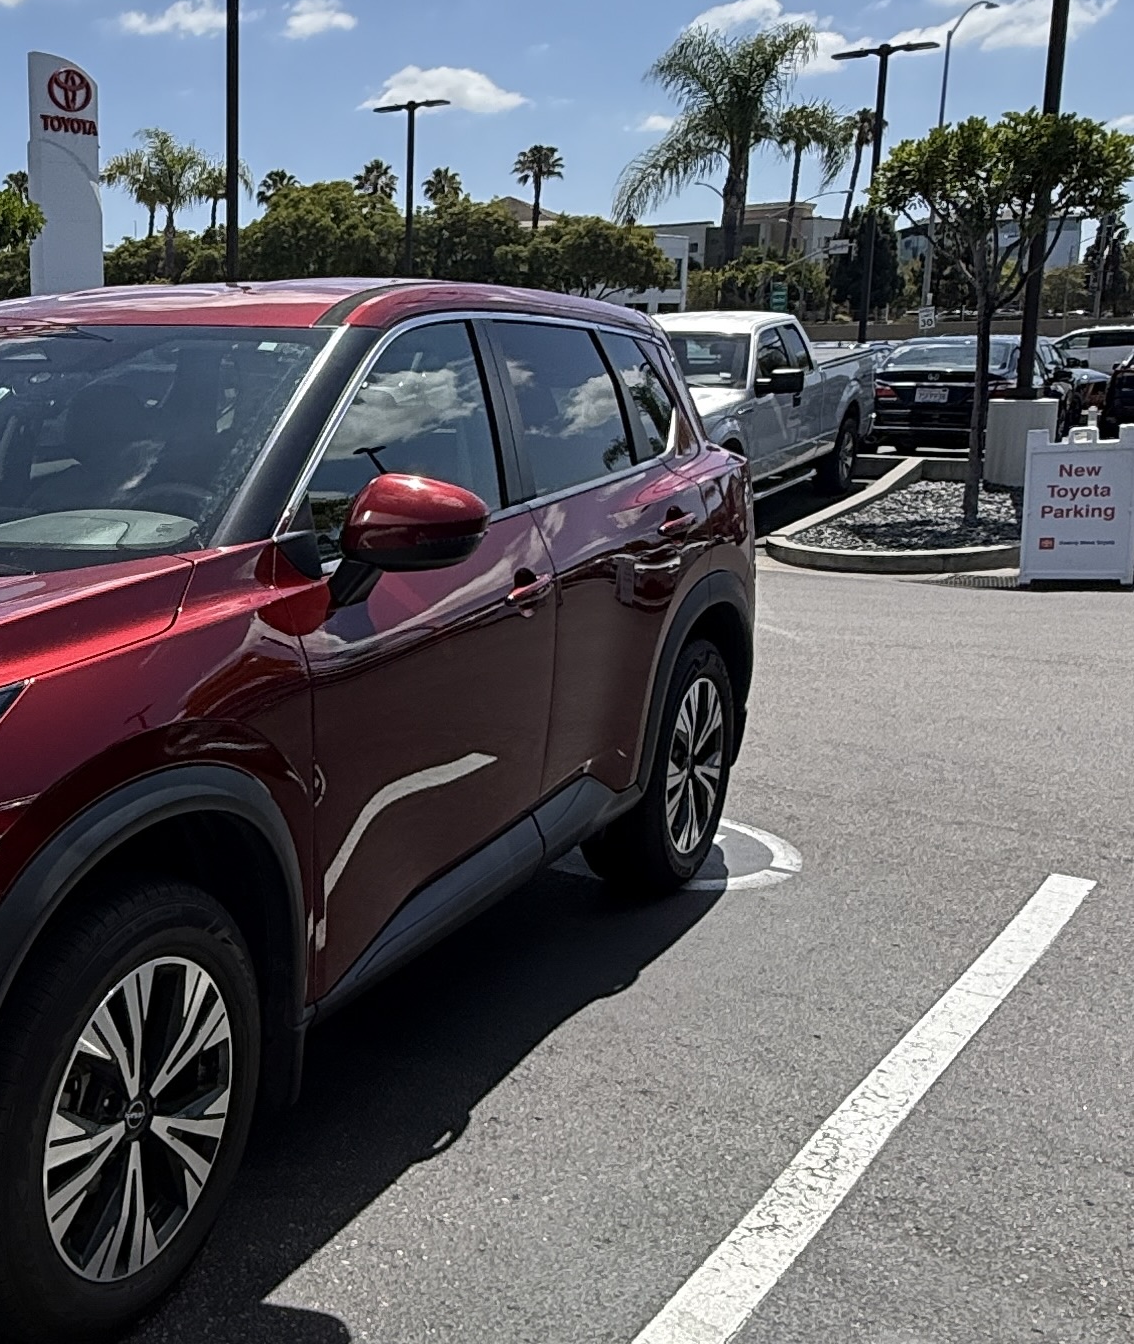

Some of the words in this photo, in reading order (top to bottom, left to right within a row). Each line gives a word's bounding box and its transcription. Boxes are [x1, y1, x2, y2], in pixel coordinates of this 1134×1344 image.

[39, 114, 98, 136] TOYOTA
[1058, 463, 1102, 478] New
[1047, 484, 1112, 501] Toyota
[1040, 504, 1116, 521] Parking
